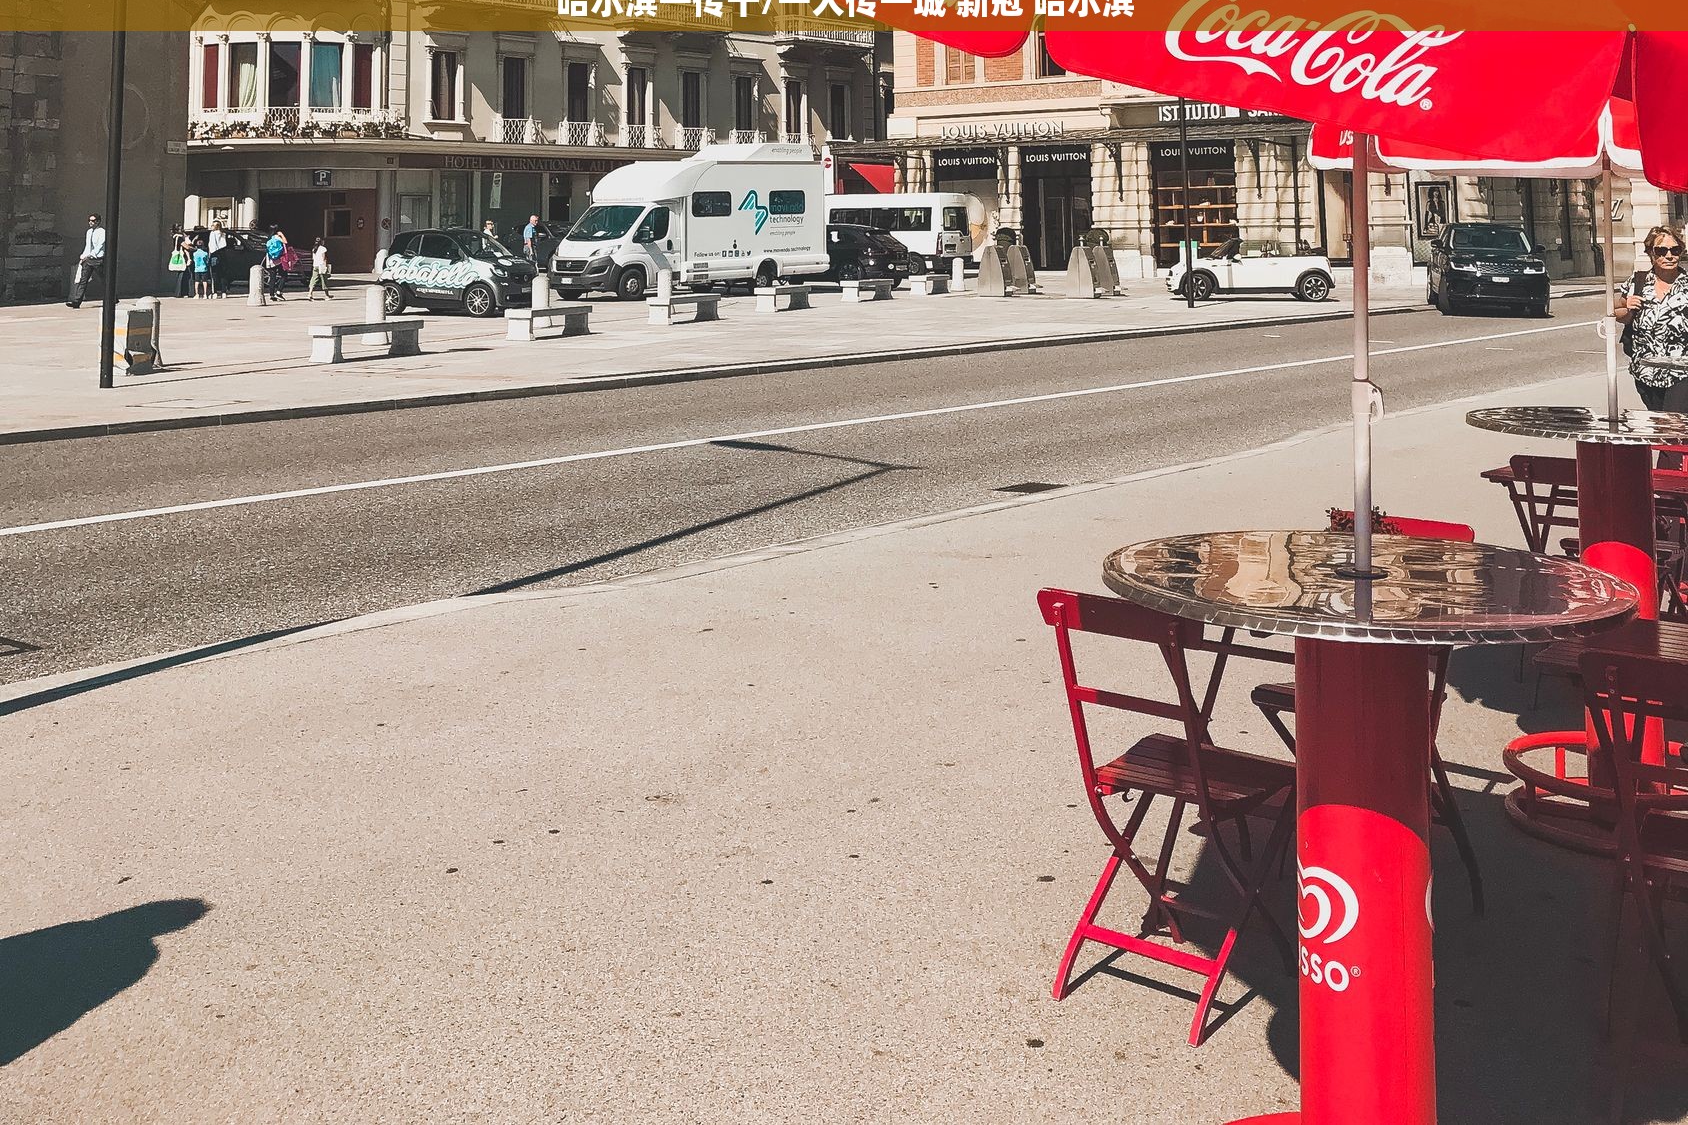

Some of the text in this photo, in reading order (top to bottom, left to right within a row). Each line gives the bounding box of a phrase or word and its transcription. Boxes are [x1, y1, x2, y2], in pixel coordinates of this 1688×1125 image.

[1158, 104, 1220, 122] ISTTUTO
[941, 120, 1064, 139] LOUIS VUITTON
[1026, 152, 1087, 162] LOUIS VUITTON
[1161, 146, 1227, 157] LOUI VUITTON
[445, 156, 486, 169] HOTEL
[492, 157, 582, 171] INTERNATIONAL
[938, 156, 995, 167] LOUIS VUITTON
[770, 215, 804, 224] technology
[1299, 942, 1349, 992] SSO
